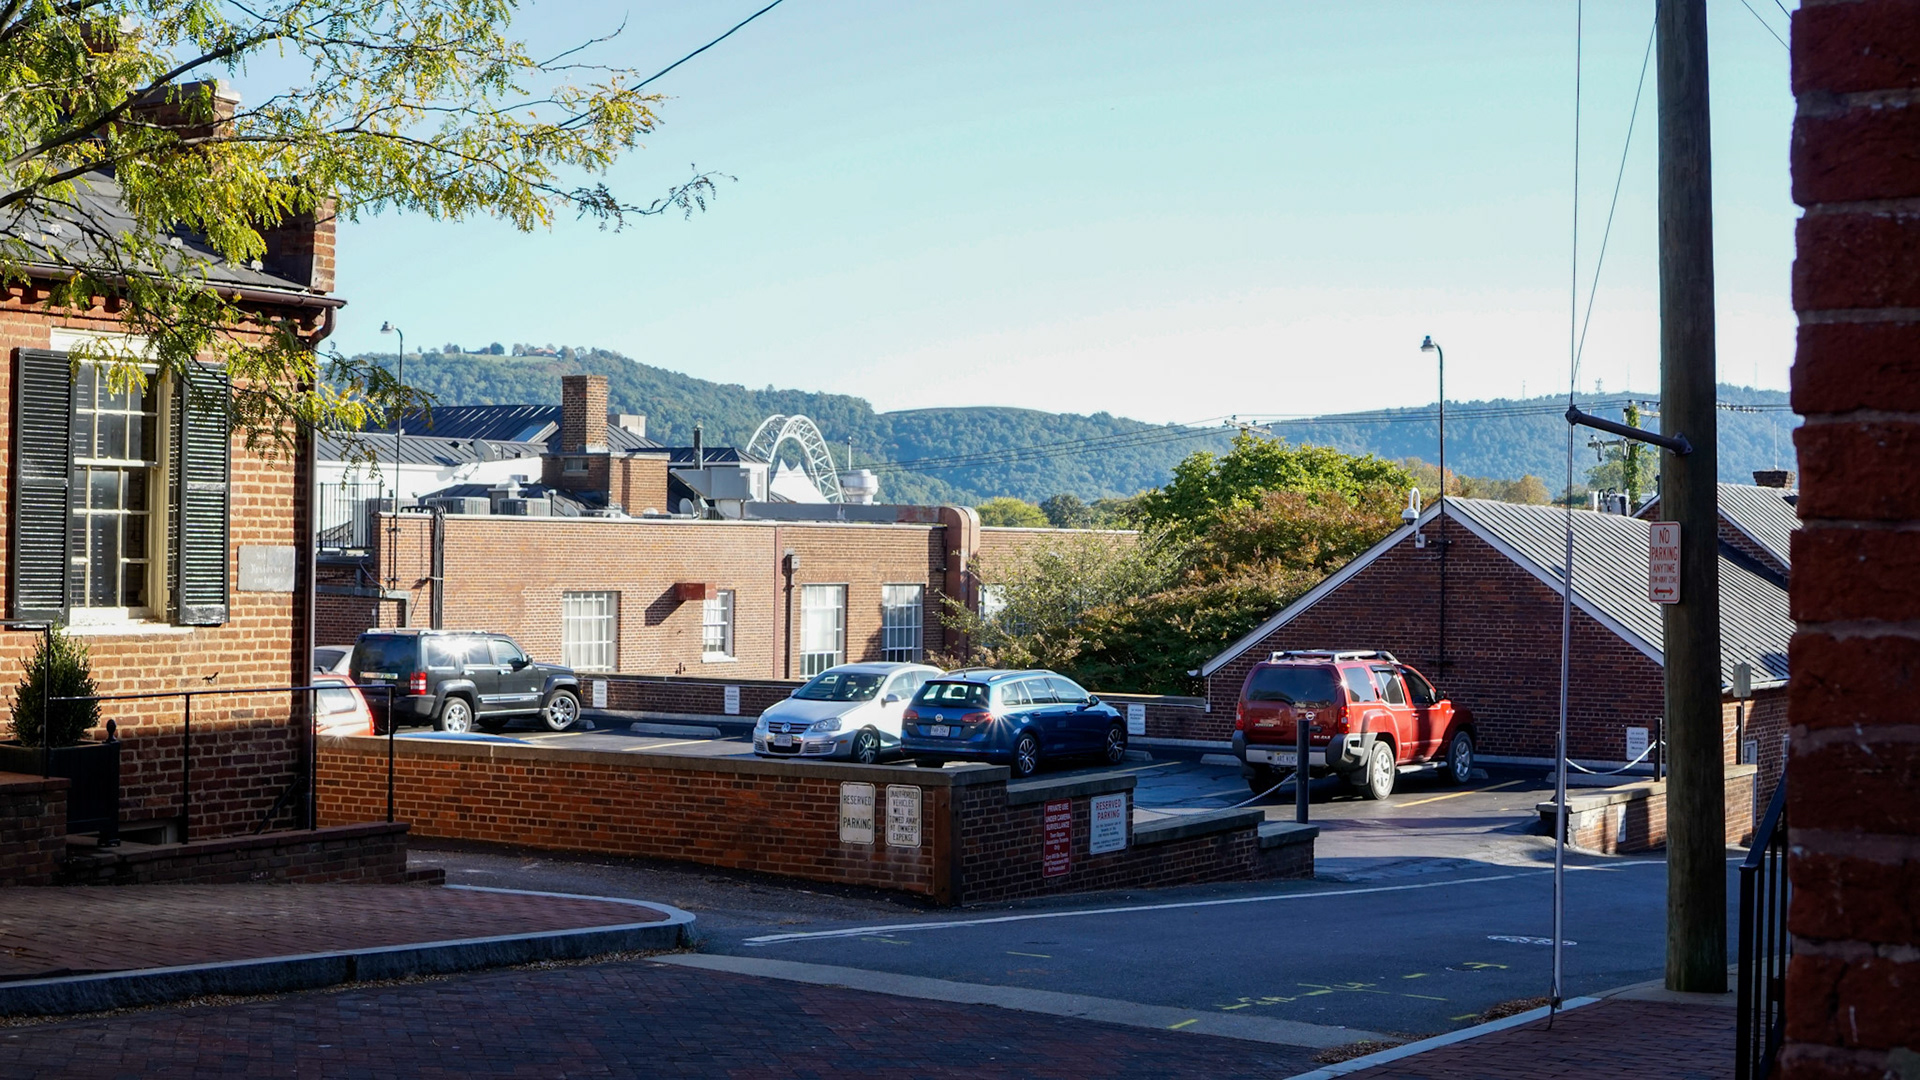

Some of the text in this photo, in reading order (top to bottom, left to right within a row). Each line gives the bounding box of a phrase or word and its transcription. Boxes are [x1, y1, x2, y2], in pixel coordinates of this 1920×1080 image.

[1659, 529, 1670, 544] NO
[1652, 546, 1677, 561] PARKING
[1653, 563, 1675, 573] ANYTIME
[843, 795, 871, 806] RESERVED
[893, 799, 914, 807] VEHICLES
[1096, 799, 1121, 810] RESERVED
[893, 807, 914, 816] WILL BE
[1047, 804, 1061, 812] PRIVATE
[1097, 809, 1120, 820] PARKING
[843, 817, 871, 830] PARKING
[890, 815, 917, 825] TOWED AWAY
[893, 833, 914, 842] EXPENSE
